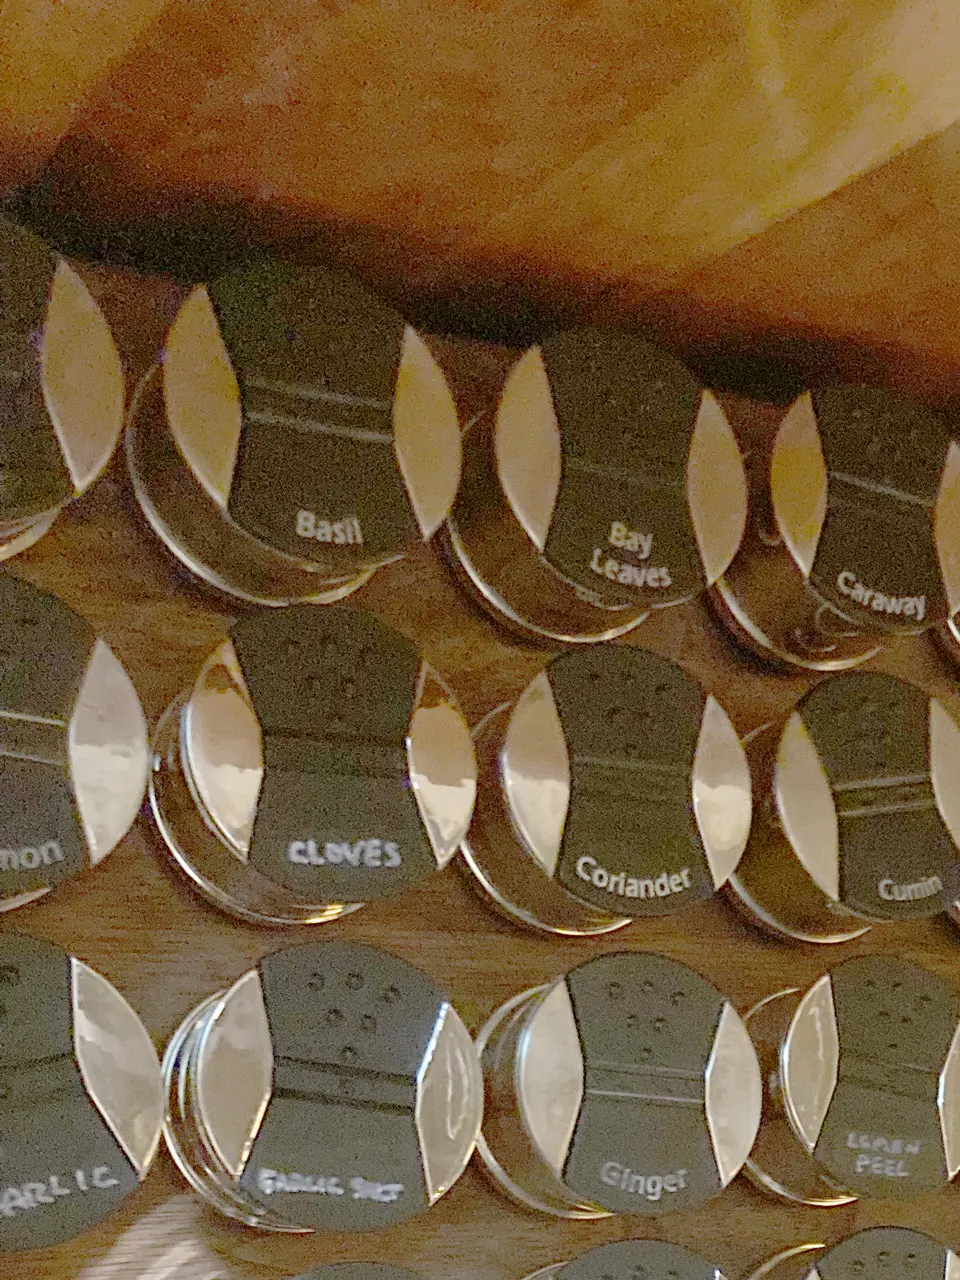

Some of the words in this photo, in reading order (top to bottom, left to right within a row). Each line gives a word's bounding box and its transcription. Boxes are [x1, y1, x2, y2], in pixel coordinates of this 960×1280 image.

[296, 508, 364, 546] Basil
[608, 520, 653, 560] Bay
[591, 547, 673, 588] Leaves
[837, 571, 926, 622] Caraway
[287, 838, 402, 868] CLOVES
[576, 855, 692, 899] Coriander
[877, 874, 944, 902] Cumin
[0, 1165, 120, 1216] ARLIC
[600, 1160, 688, 1203] Ginger
